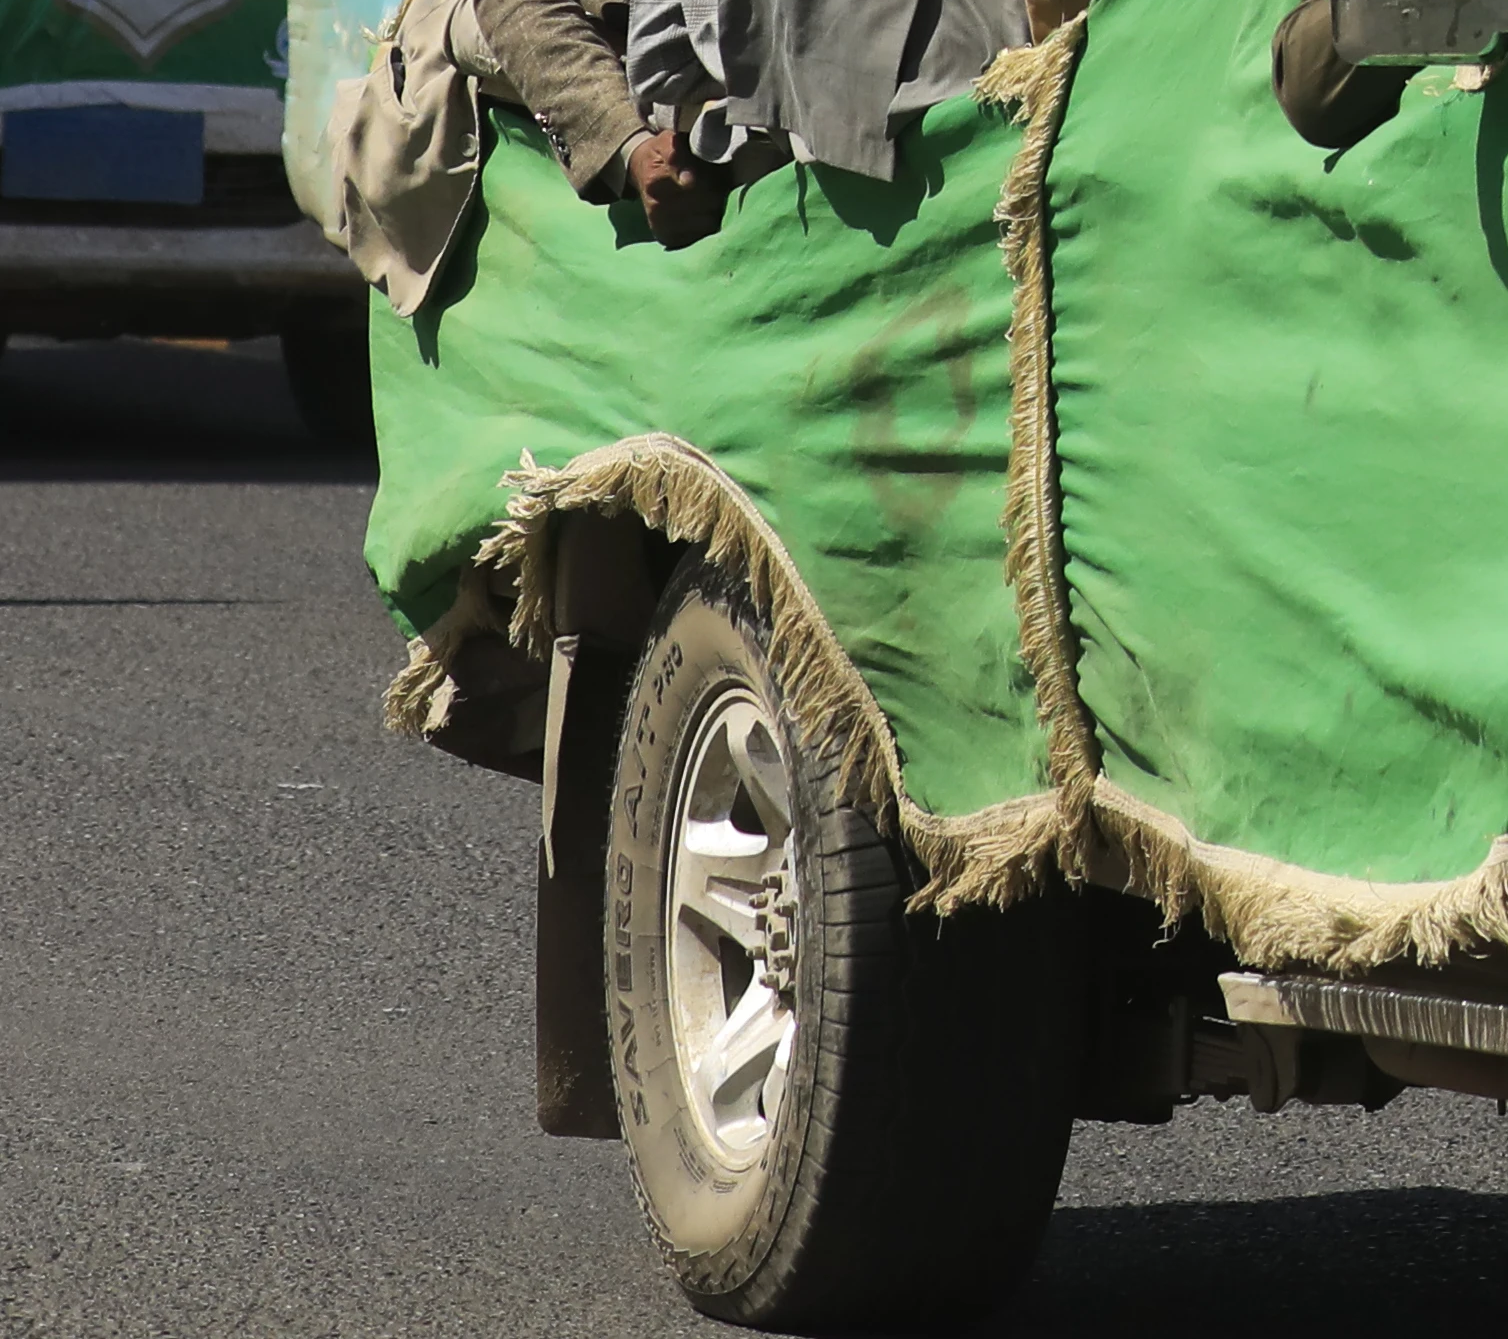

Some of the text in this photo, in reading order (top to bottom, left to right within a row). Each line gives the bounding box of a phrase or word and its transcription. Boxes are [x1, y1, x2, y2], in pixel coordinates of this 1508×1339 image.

[615, 641, 684, 1126] SAVERO A/T PRO
